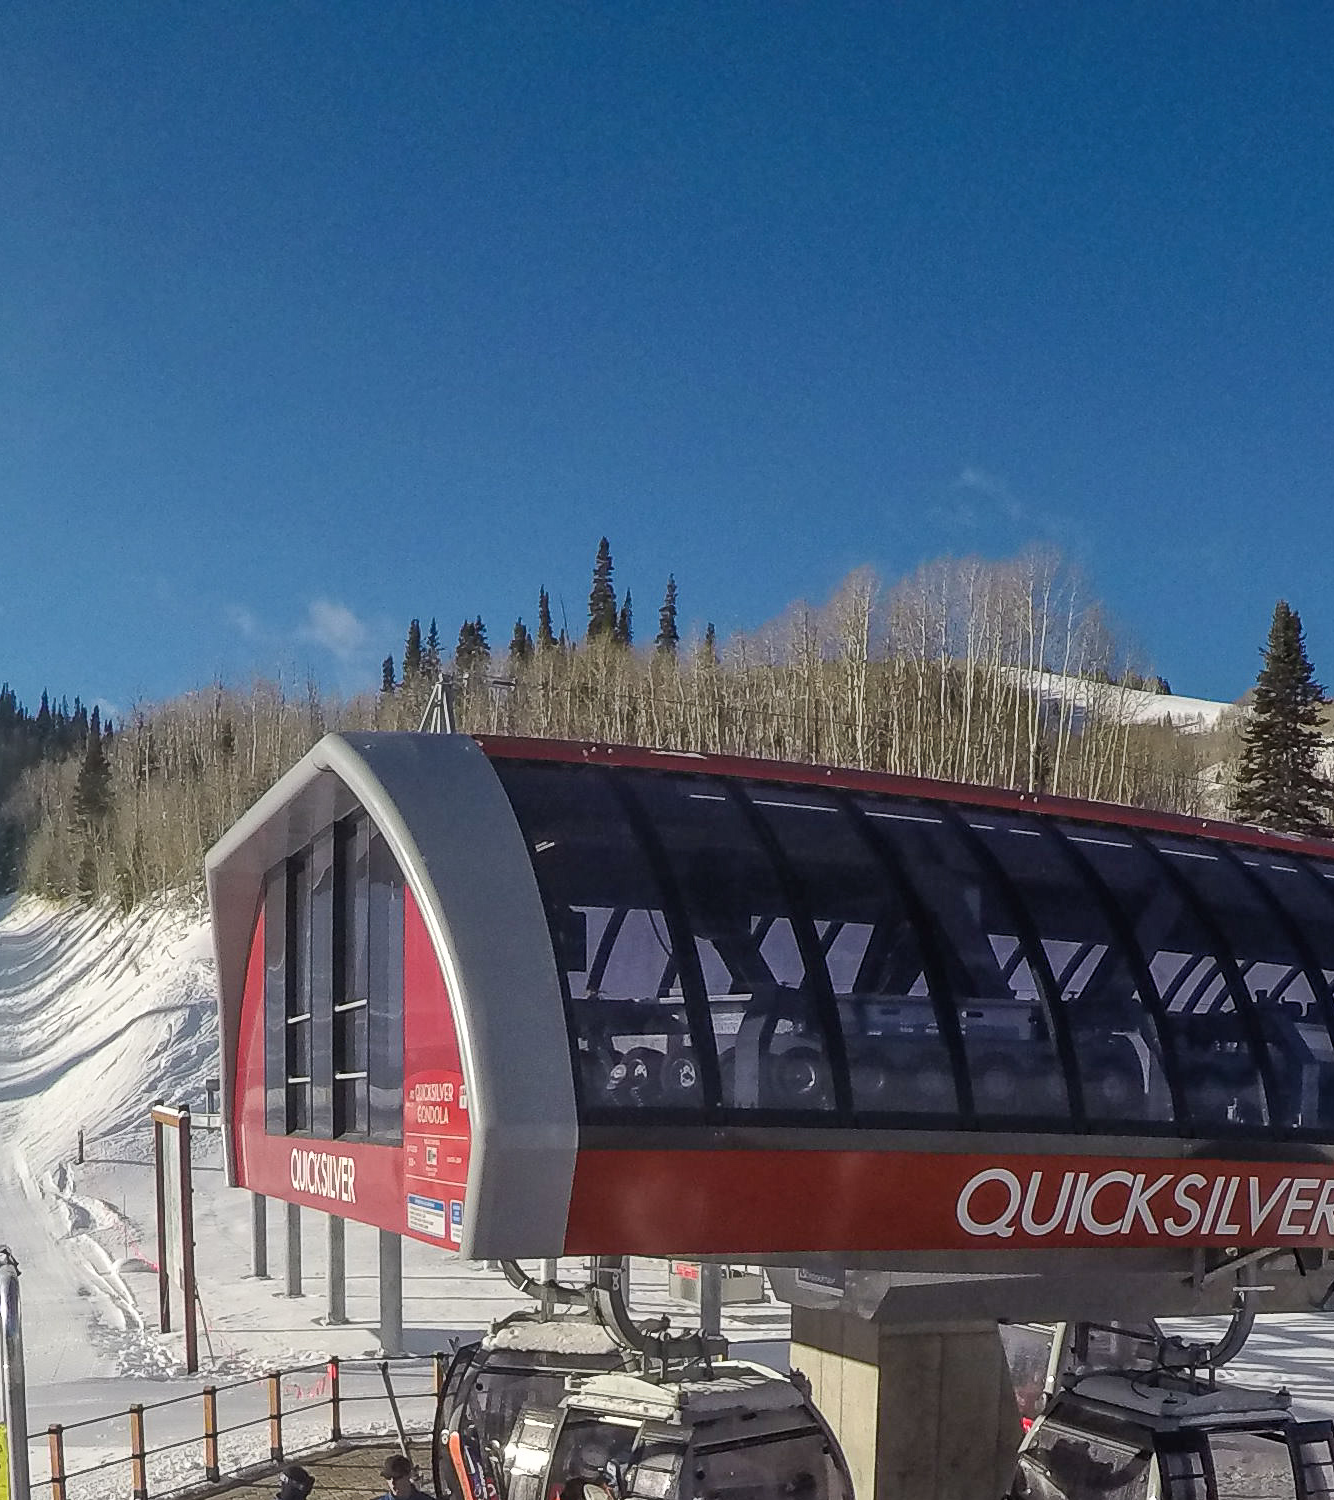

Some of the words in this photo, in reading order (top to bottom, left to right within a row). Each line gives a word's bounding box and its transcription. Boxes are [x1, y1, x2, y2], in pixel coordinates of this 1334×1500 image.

[415, 1083, 454, 1102] QUICKSILVER
[417, 1105, 449, 1125] GONDOLA
[290, 1147, 357, 1204] QUICKSILVER
